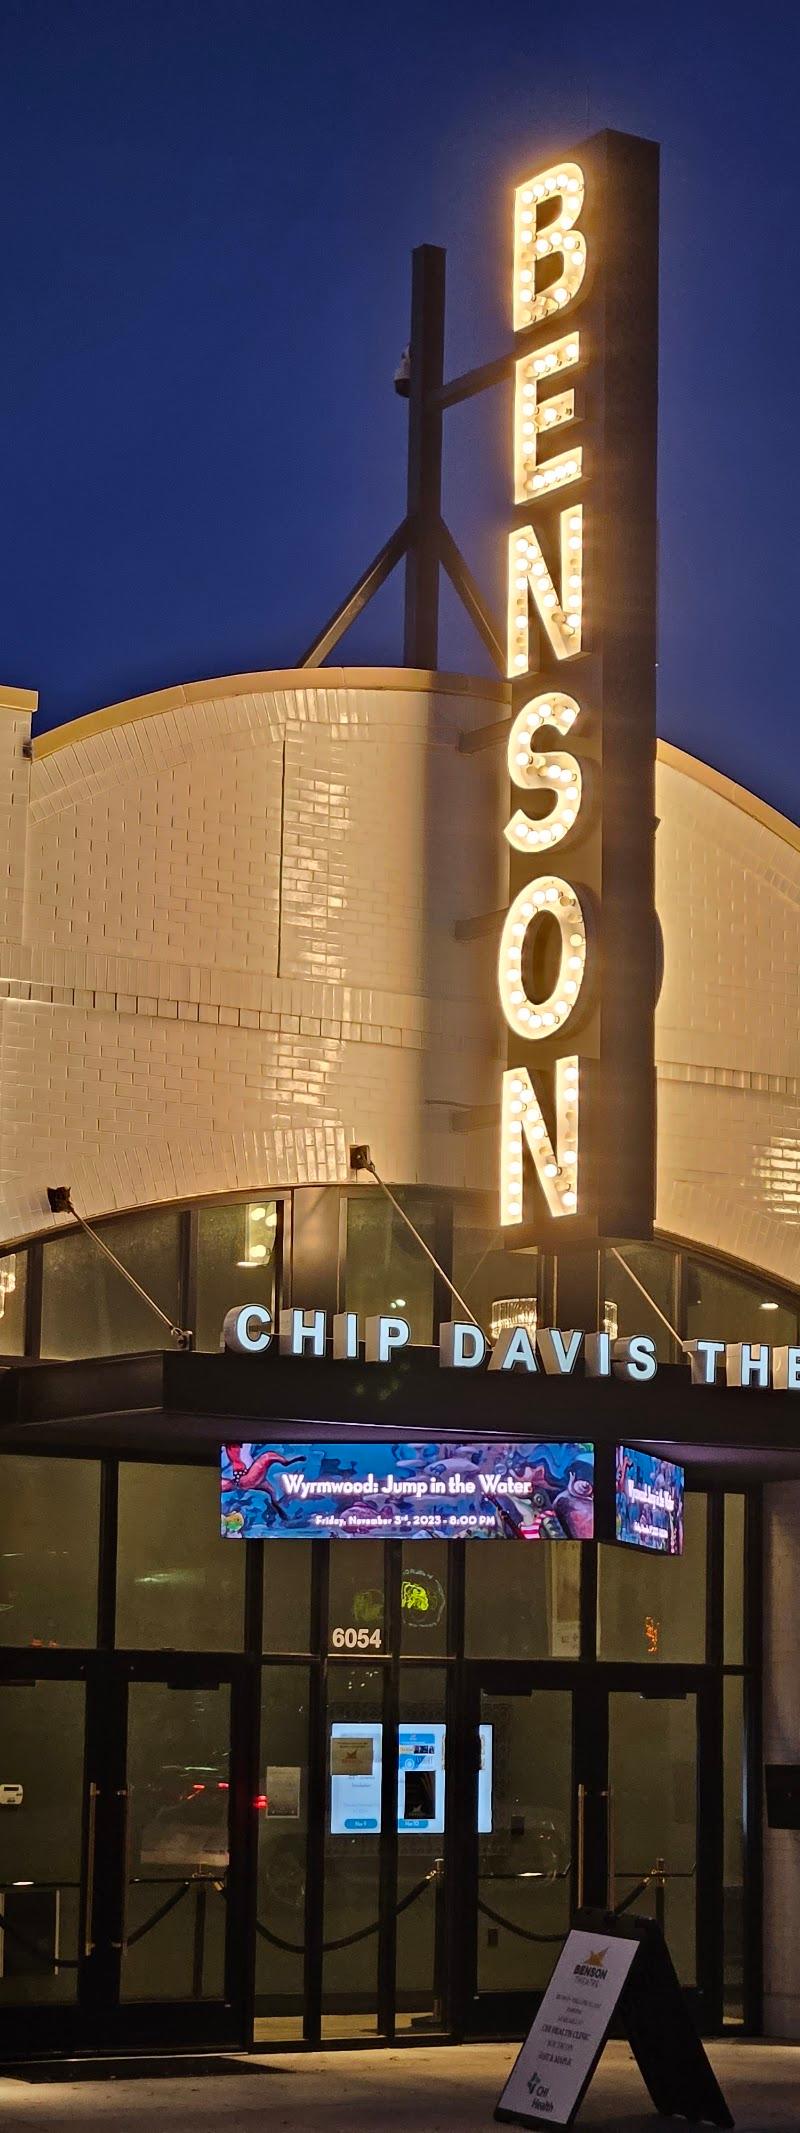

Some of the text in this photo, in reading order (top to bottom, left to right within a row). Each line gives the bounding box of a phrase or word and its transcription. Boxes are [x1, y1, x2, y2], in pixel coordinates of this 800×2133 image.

[498, 161, 587, 1227] BENSON
[228, 1304, 411, 1363] CHIP
[445, 1320, 657, 1381] DAVIS
[281, 1474, 532, 1498] Wyrmwood: Jump in the Water
[315, 1515, 347, 1527] Friday,
[348, 1515, 392, 1526] November
[413, 1515, 441, 1526] 2023
[449, 1515, 476, 1526] 8:00
[479, 1515, 495, 1526] PM
[332, 1628, 382, 1649] 6054
[573, 1965, 608, 1980] BENSON
[531, 2098, 554, 2112] Health
